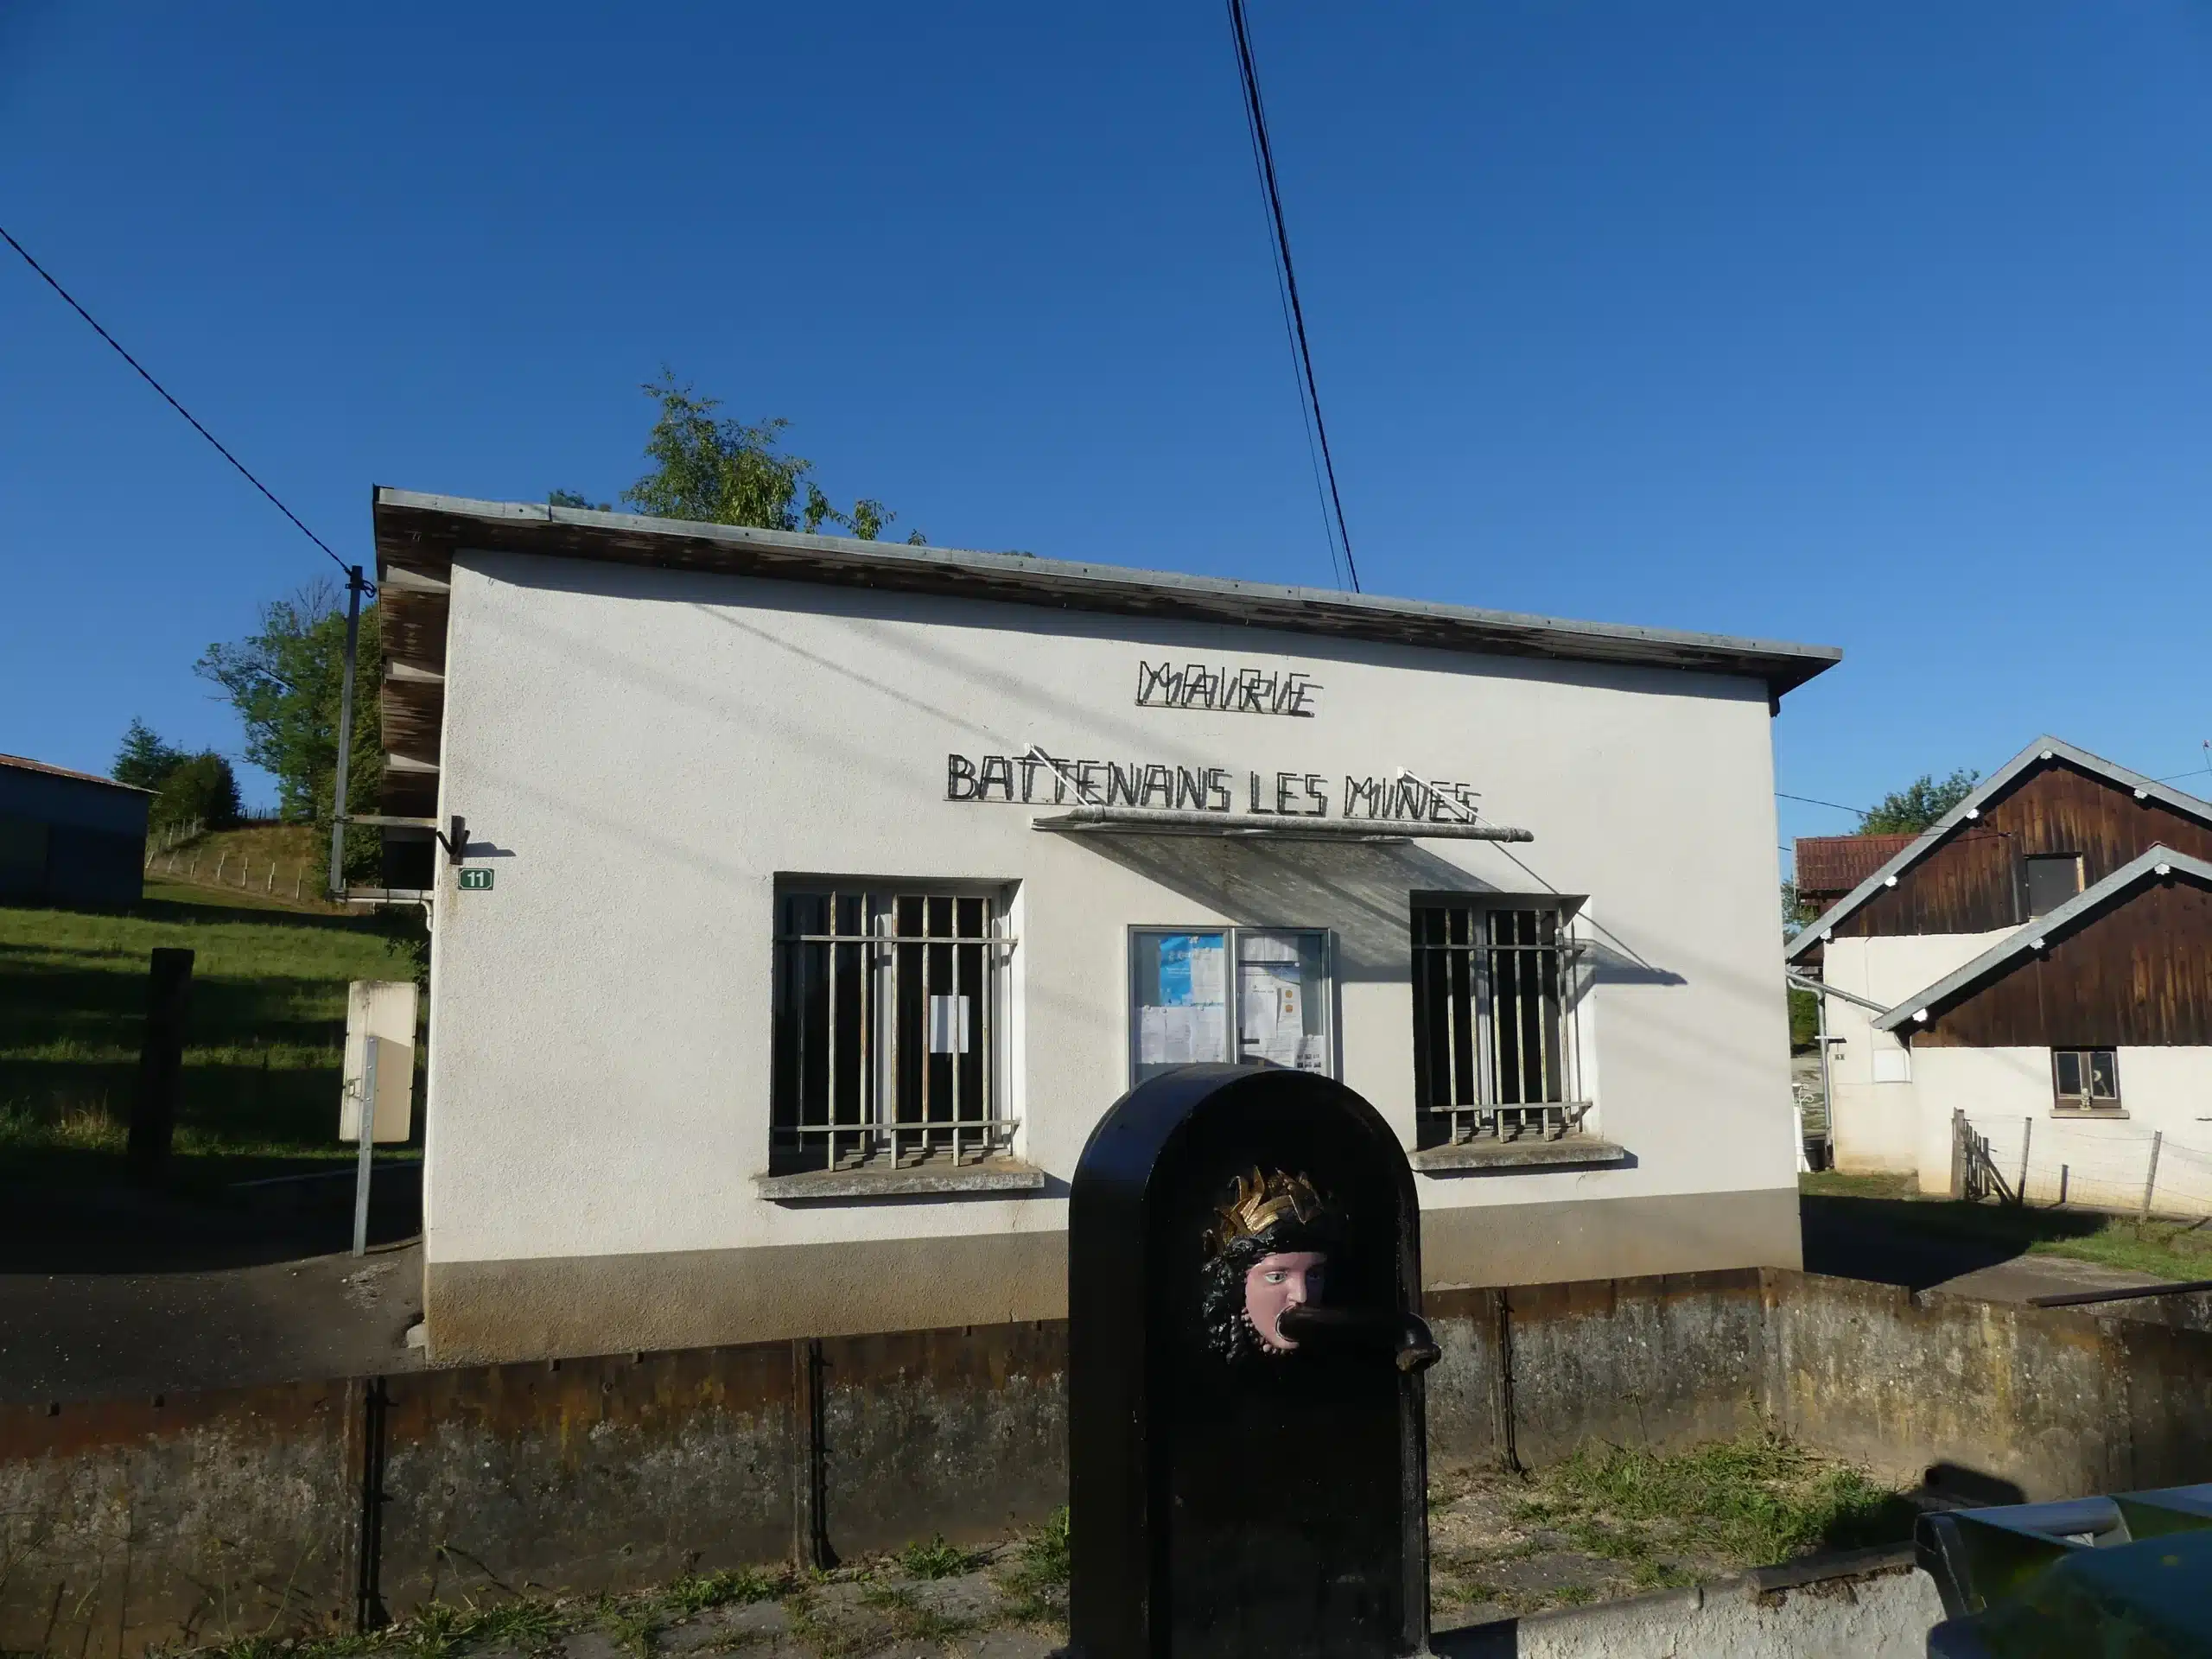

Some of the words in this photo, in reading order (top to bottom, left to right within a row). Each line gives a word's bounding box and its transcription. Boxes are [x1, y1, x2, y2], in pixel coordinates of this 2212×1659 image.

[1137, 661, 1312, 715] MAIRIE
[947, 753, 1228, 810] BATTENANS
[1249, 771, 1324, 815] LES
[1343, 775, 1474, 823] MINES
[467, 871, 484, 887] 11
